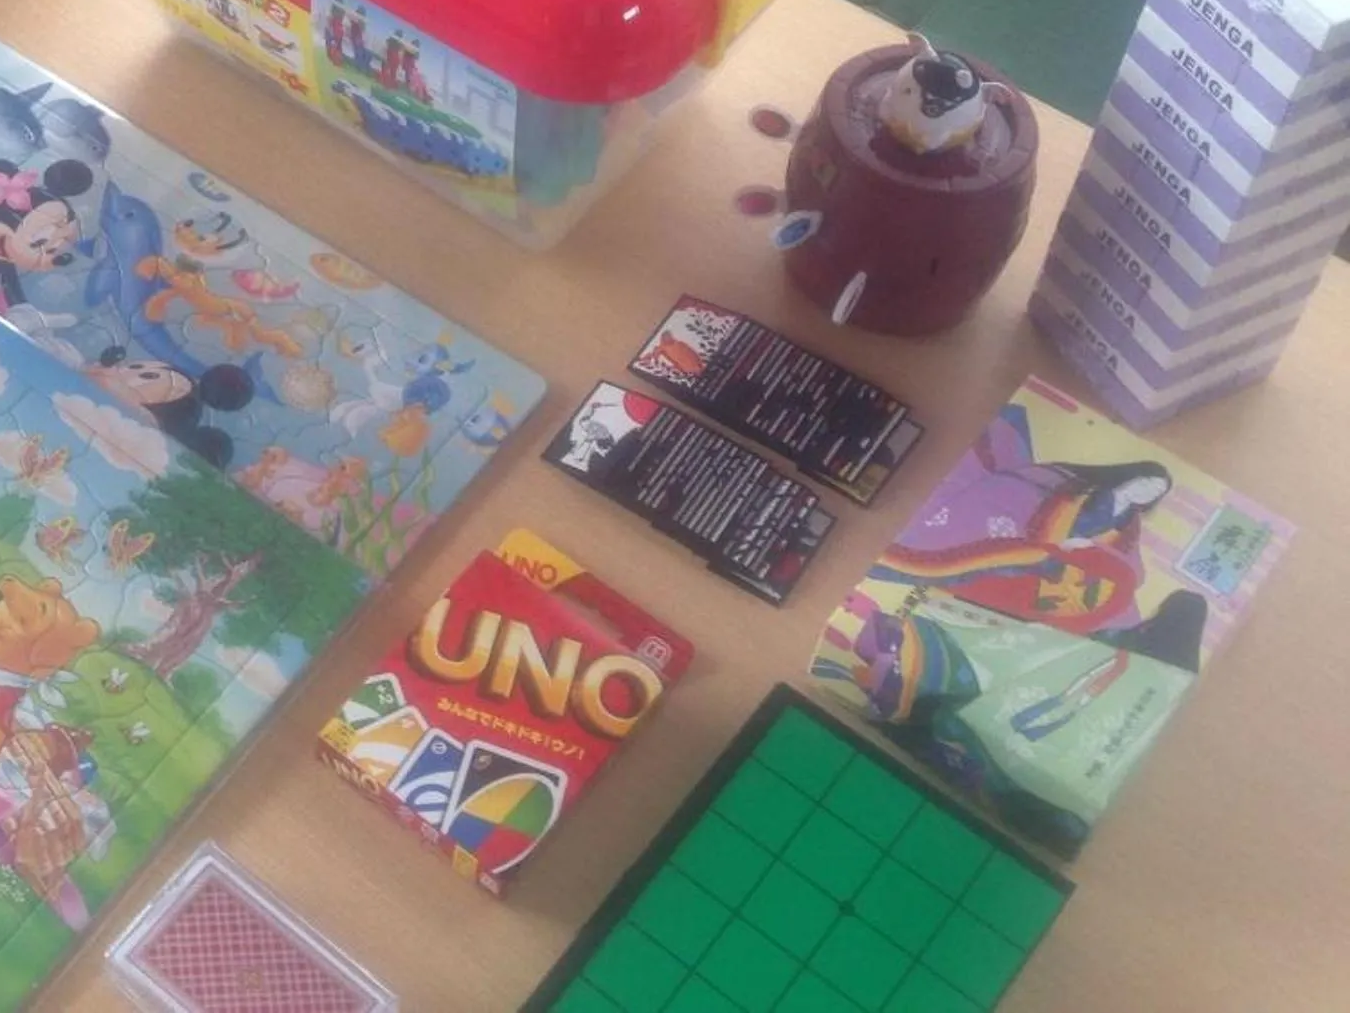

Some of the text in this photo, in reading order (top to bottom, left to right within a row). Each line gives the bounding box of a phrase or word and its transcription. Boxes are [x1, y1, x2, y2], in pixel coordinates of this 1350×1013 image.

[1170, 45, 1234, 113] JENGA
[1150, 92, 1212, 160] JENGA
[1130, 138, 1192, 207] JENGA
[1112, 183, 1172, 252] JENGA
[1096, 225, 1153, 290] JENGA
[1079, 269, 1137, 333] JENGA
[1062, 308, 1120, 372] JENGA
[503, 551, 558, 585] UNO
[409, 587, 664, 739] UNO
